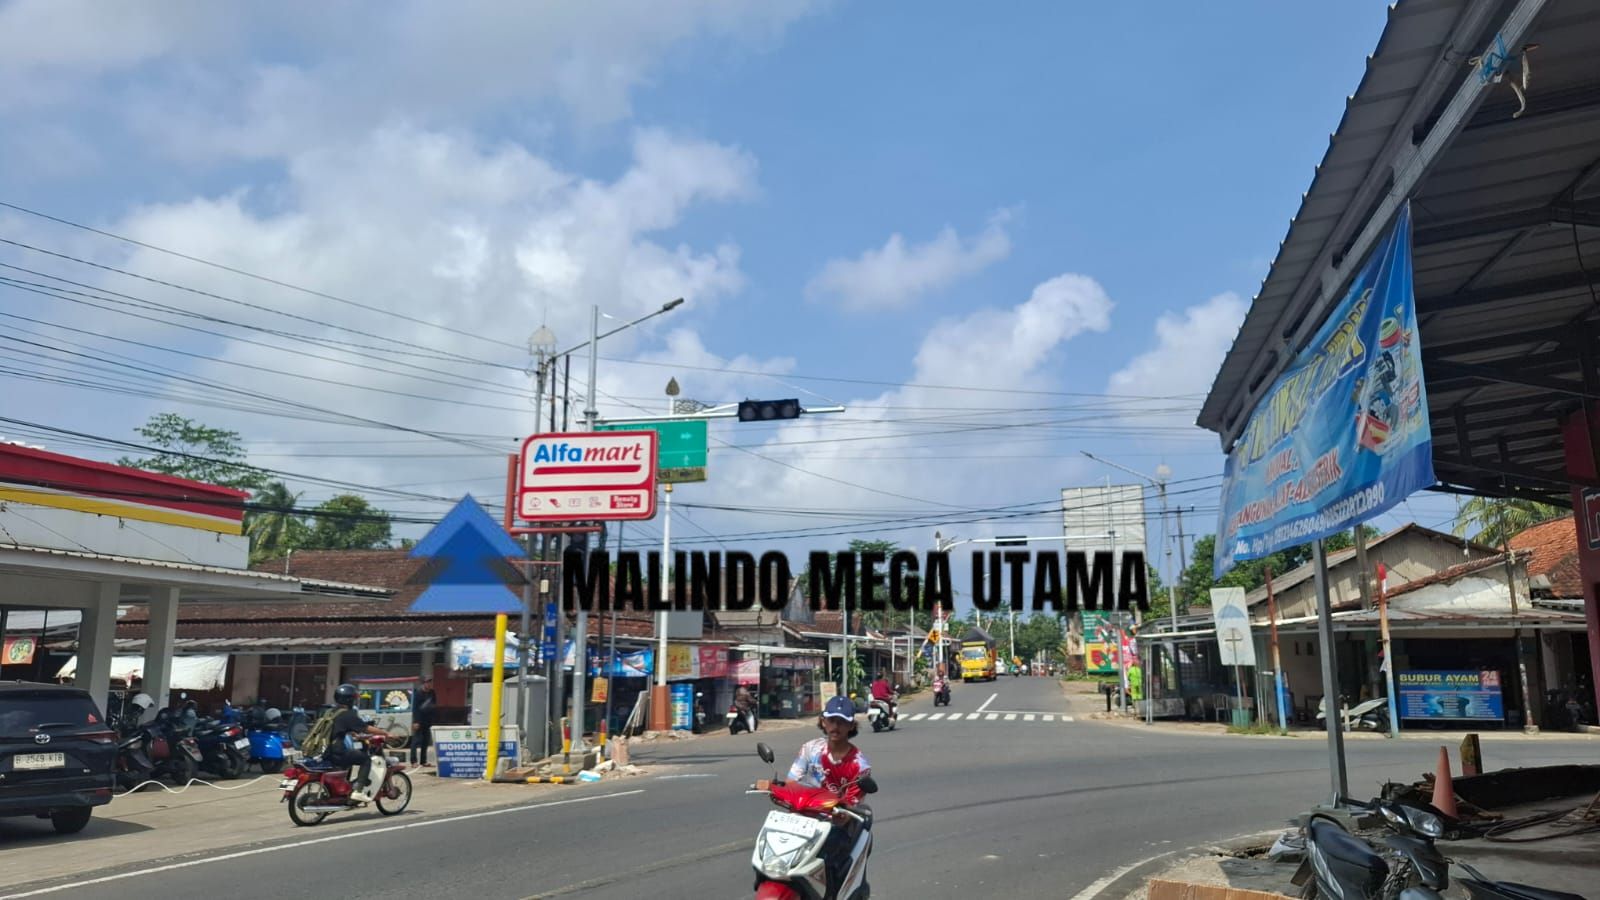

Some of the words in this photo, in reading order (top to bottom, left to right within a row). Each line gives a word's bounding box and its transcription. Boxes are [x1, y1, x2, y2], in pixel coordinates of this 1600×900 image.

[534, 443, 642, 463] Alfamart
[1400, 673, 1442, 682] BUBUR
[1446, 674, 1479, 682] AYAM
[1481, 670, 1497, 681] 24
[440, 743, 474, 751] MOHON
